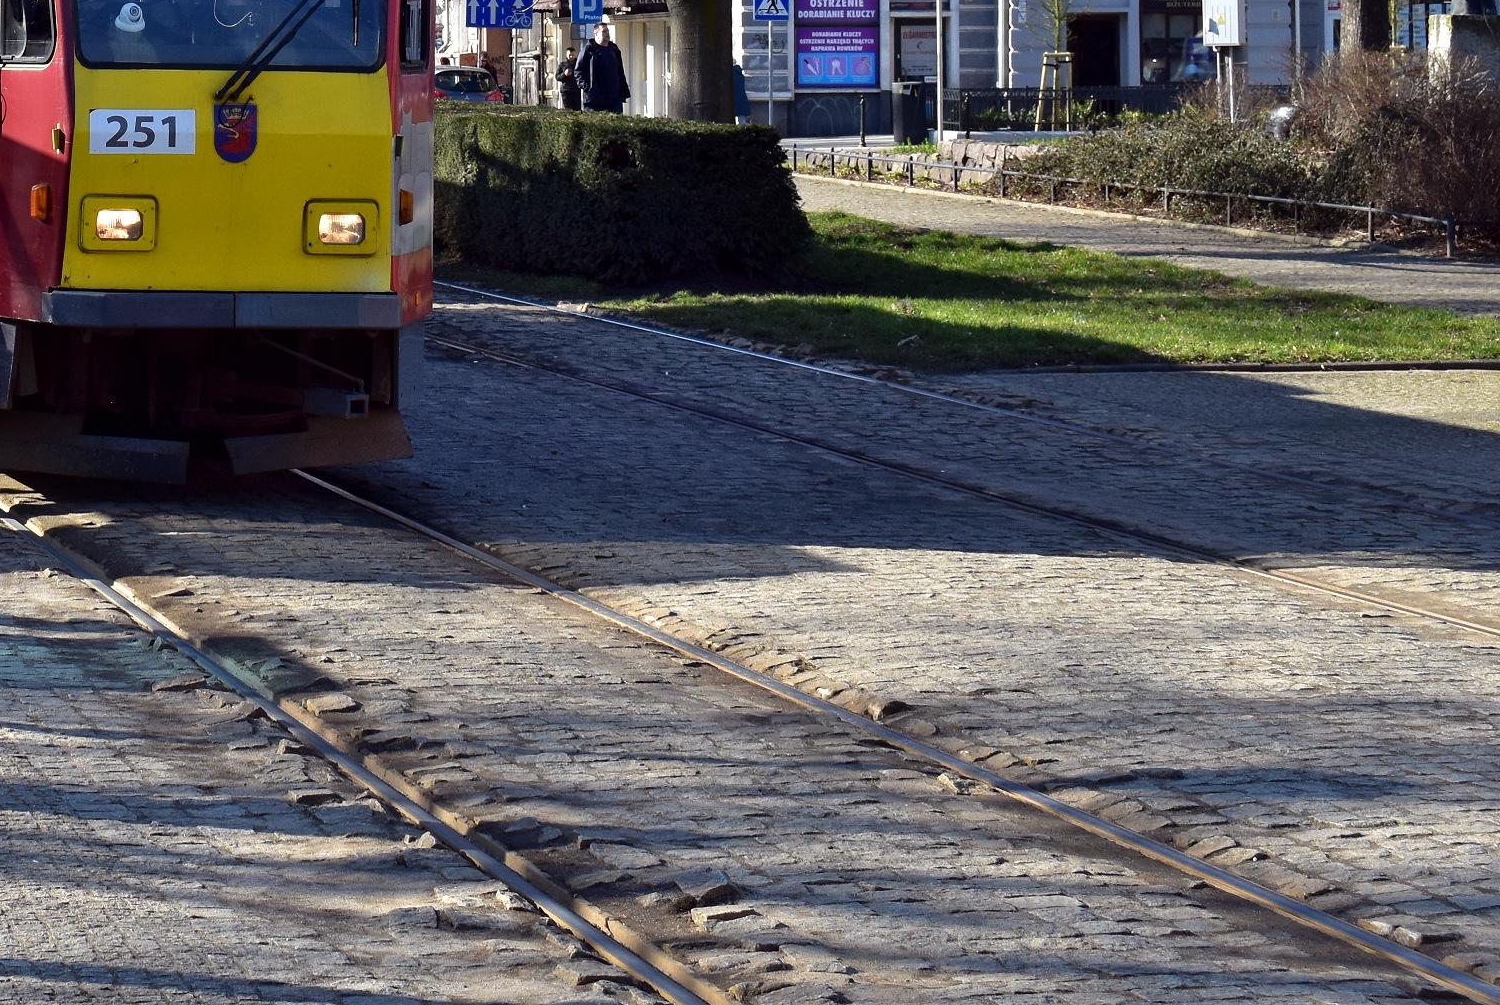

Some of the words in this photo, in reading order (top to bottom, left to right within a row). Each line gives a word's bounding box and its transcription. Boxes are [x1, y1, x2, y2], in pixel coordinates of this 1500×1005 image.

[798, 10, 844, 19] DORABIANIE
[846, 10, 876, 19] KLUCZY
[104, 115, 177, 148] 251
